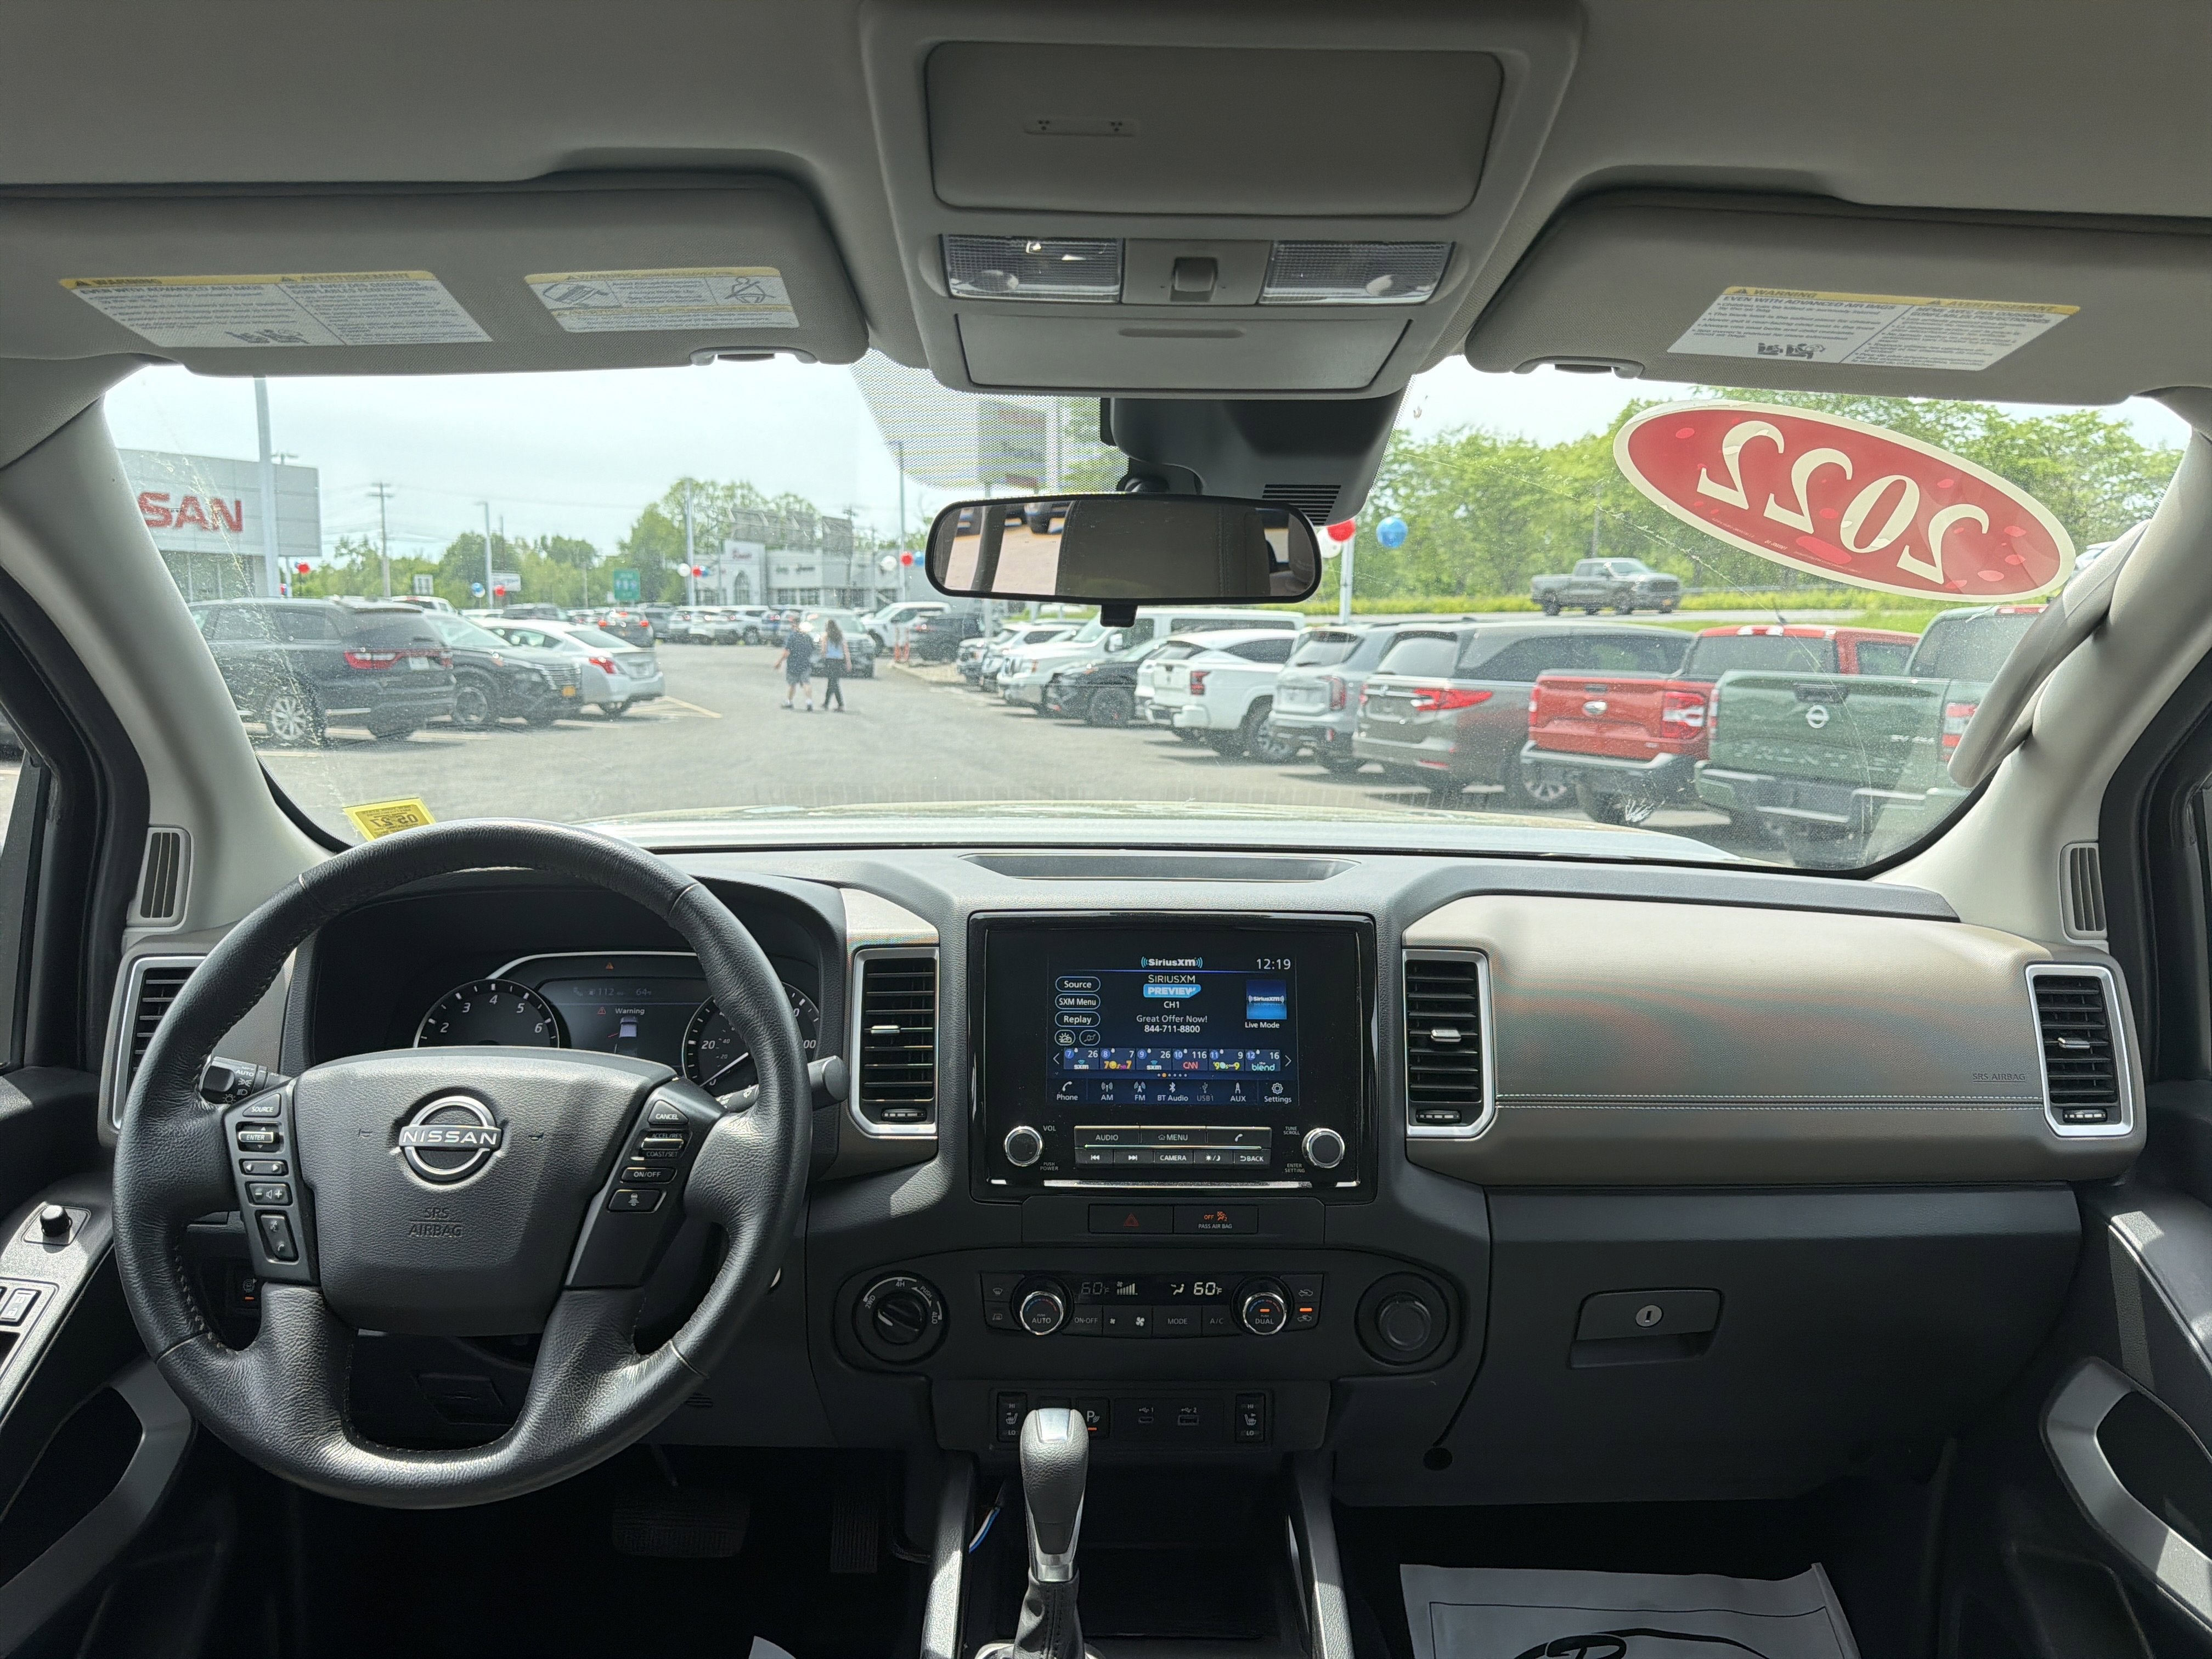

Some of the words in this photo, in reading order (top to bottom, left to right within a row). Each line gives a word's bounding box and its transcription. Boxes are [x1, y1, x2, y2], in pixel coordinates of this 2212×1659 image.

[1754, 289, 1817, 298] WARNING
[139, 492, 242, 532] SAN
[1256, 958, 1291, 970] 12:19
[1148, 975, 1195, 983] SIRIUSXM
[1148, 987, 1196, 995] PREVIEW
[489, 995, 498, 1005] 4
[1163, 1001, 1180, 1009] CH1
[462, 1002, 471, 1013] 3
[516, 1003, 524, 1013] 5
[1064, 1015, 1092, 1025] Replay
[1186, 1015, 1207, 1023] Now!
[439, 1023, 449, 1033] 2
[534, 1023, 543, 1033] 6
[701, 1040, 715, 1049] 20
[403, 1130, 497, 1145] NISSAN
[424, 1207, 450, 1219] SRS
[410, 1224, 462, 1237] AIRBAG
[919, 1285, 933, 1298] PUSH
[865, 1295, 876, 1310] 2WD
